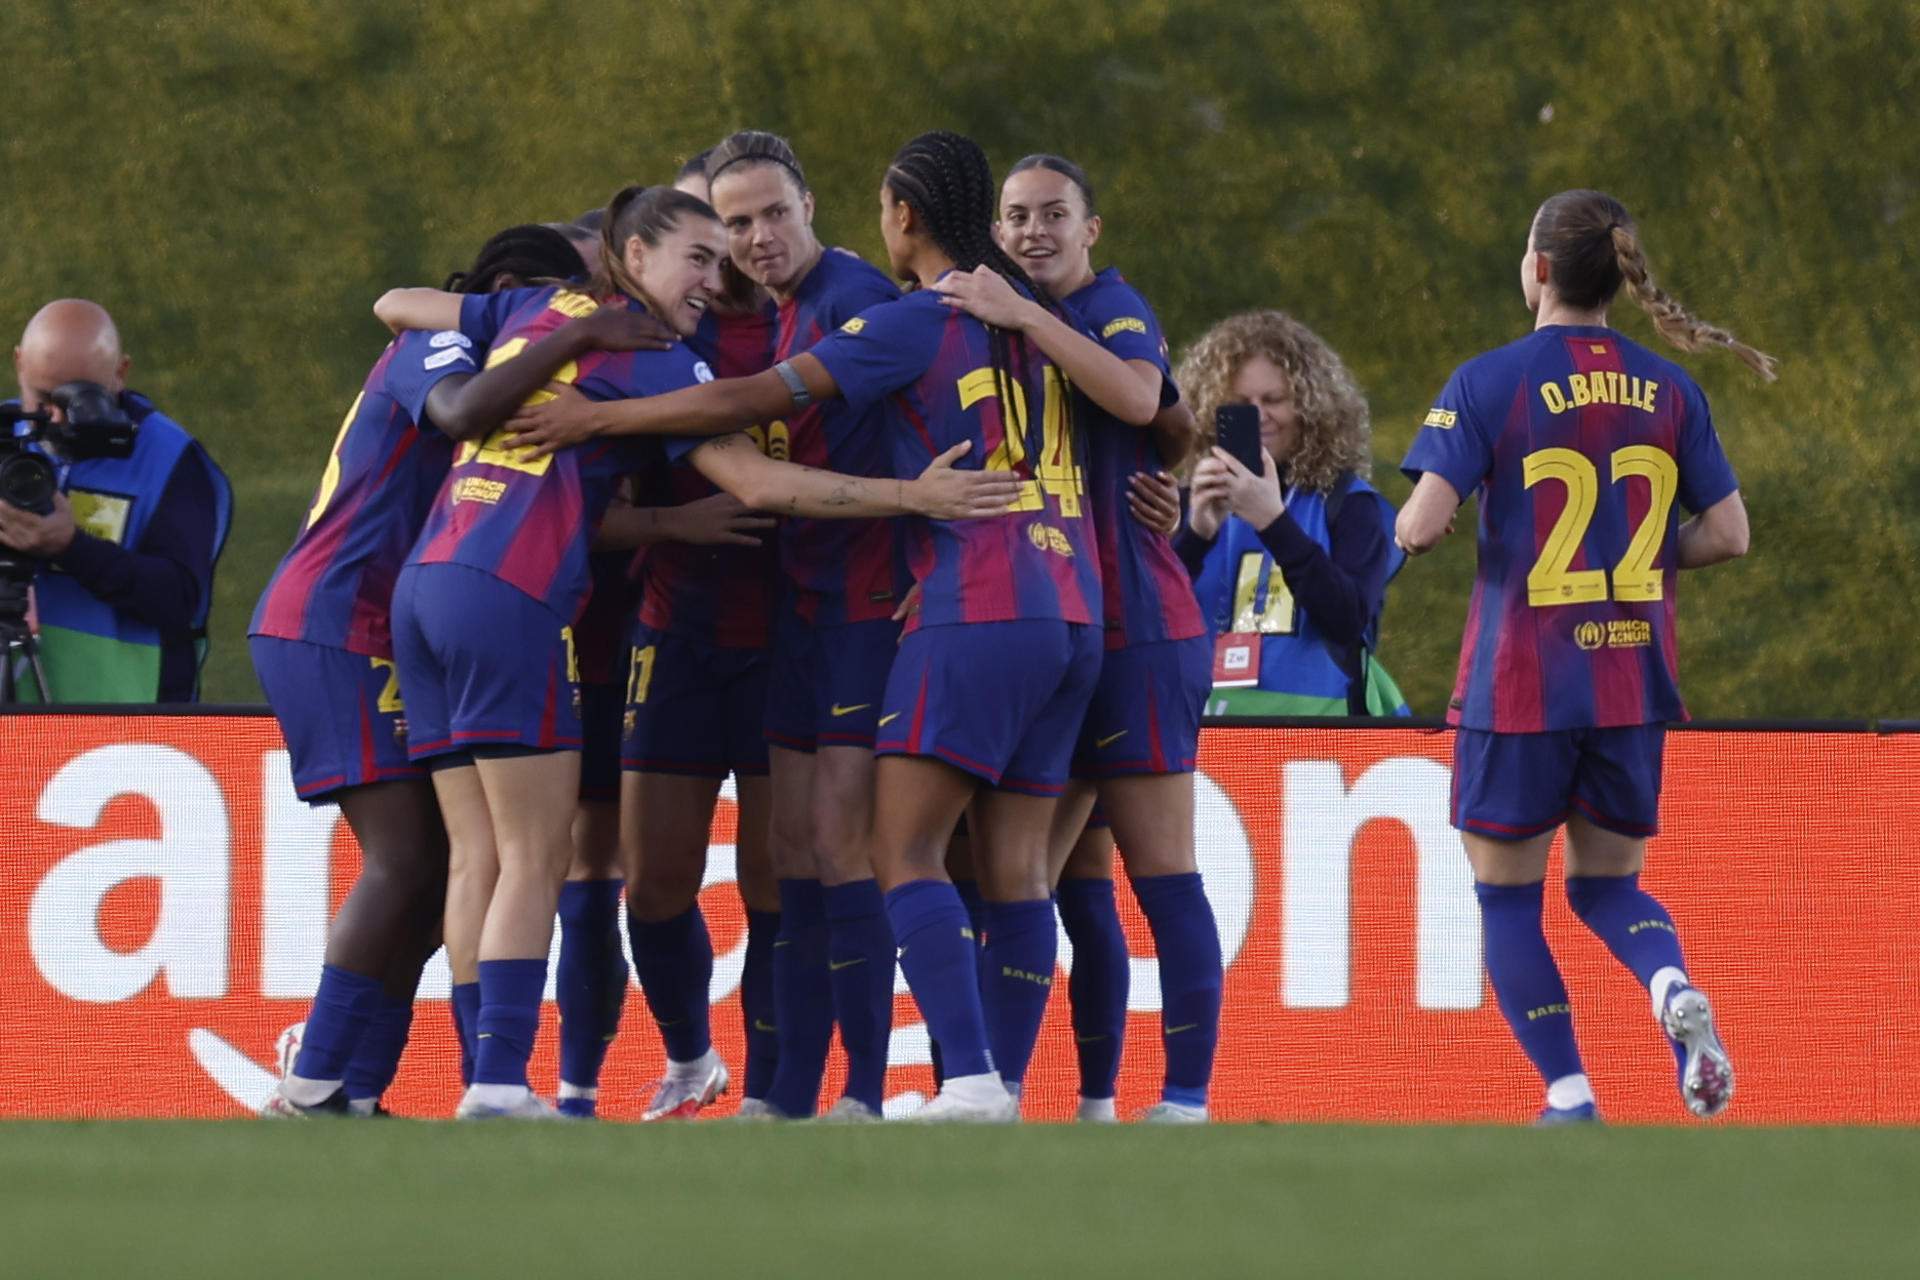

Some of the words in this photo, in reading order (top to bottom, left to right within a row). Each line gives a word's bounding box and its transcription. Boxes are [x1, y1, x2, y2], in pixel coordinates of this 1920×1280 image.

[957, 365, 1084, 518] 24
[1540, 371, 1659, 414] O.BATLLE
[1523, 445, 1679, 606] 22
